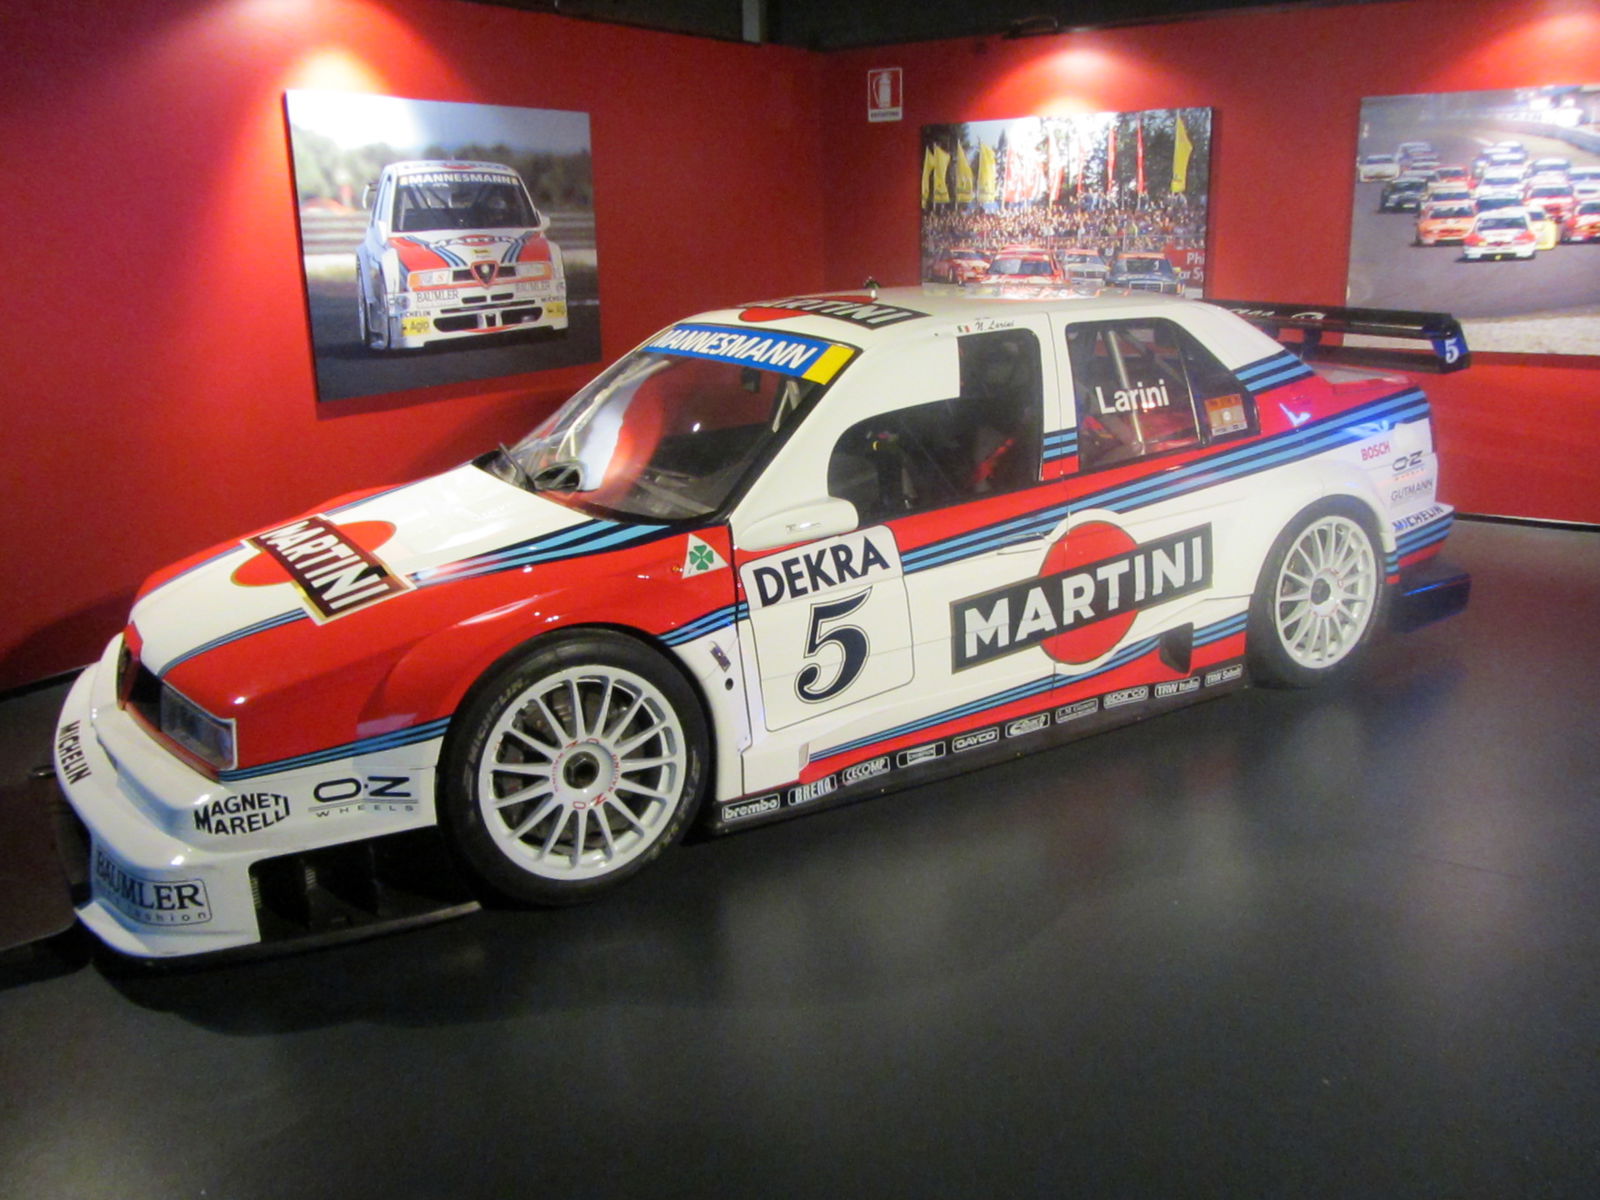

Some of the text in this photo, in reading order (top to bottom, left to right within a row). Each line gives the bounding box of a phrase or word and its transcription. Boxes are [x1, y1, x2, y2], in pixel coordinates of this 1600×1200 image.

[408, 173, 511, 184] MANNESMANN
[650, 329, 818, 369] MANNESMANN
[1445, 338, 1458, 364] 5
[1095, 379, 1170, 414] Larini
[1361, 441, 1391, 461] BOSCH
[1391, 480, 1433, 501] GUTMANN
[1392, 505, 1444, 531] MICHELIN
[259, 520, 390, 610] MARTINI
[752, 536, 891, 607] DEKRA
[964, 535, 1203, 658] MARTINI
[794, 585, 873, 704] 5
[58, 719, 92, 785] MICHELIN
[956, 731, 996, 748] DAYCO
[846, 759, 886, 781] CECOMP
[315, 805, 415, 817] WHEELS
[724, 796, 778, 819] brembo
